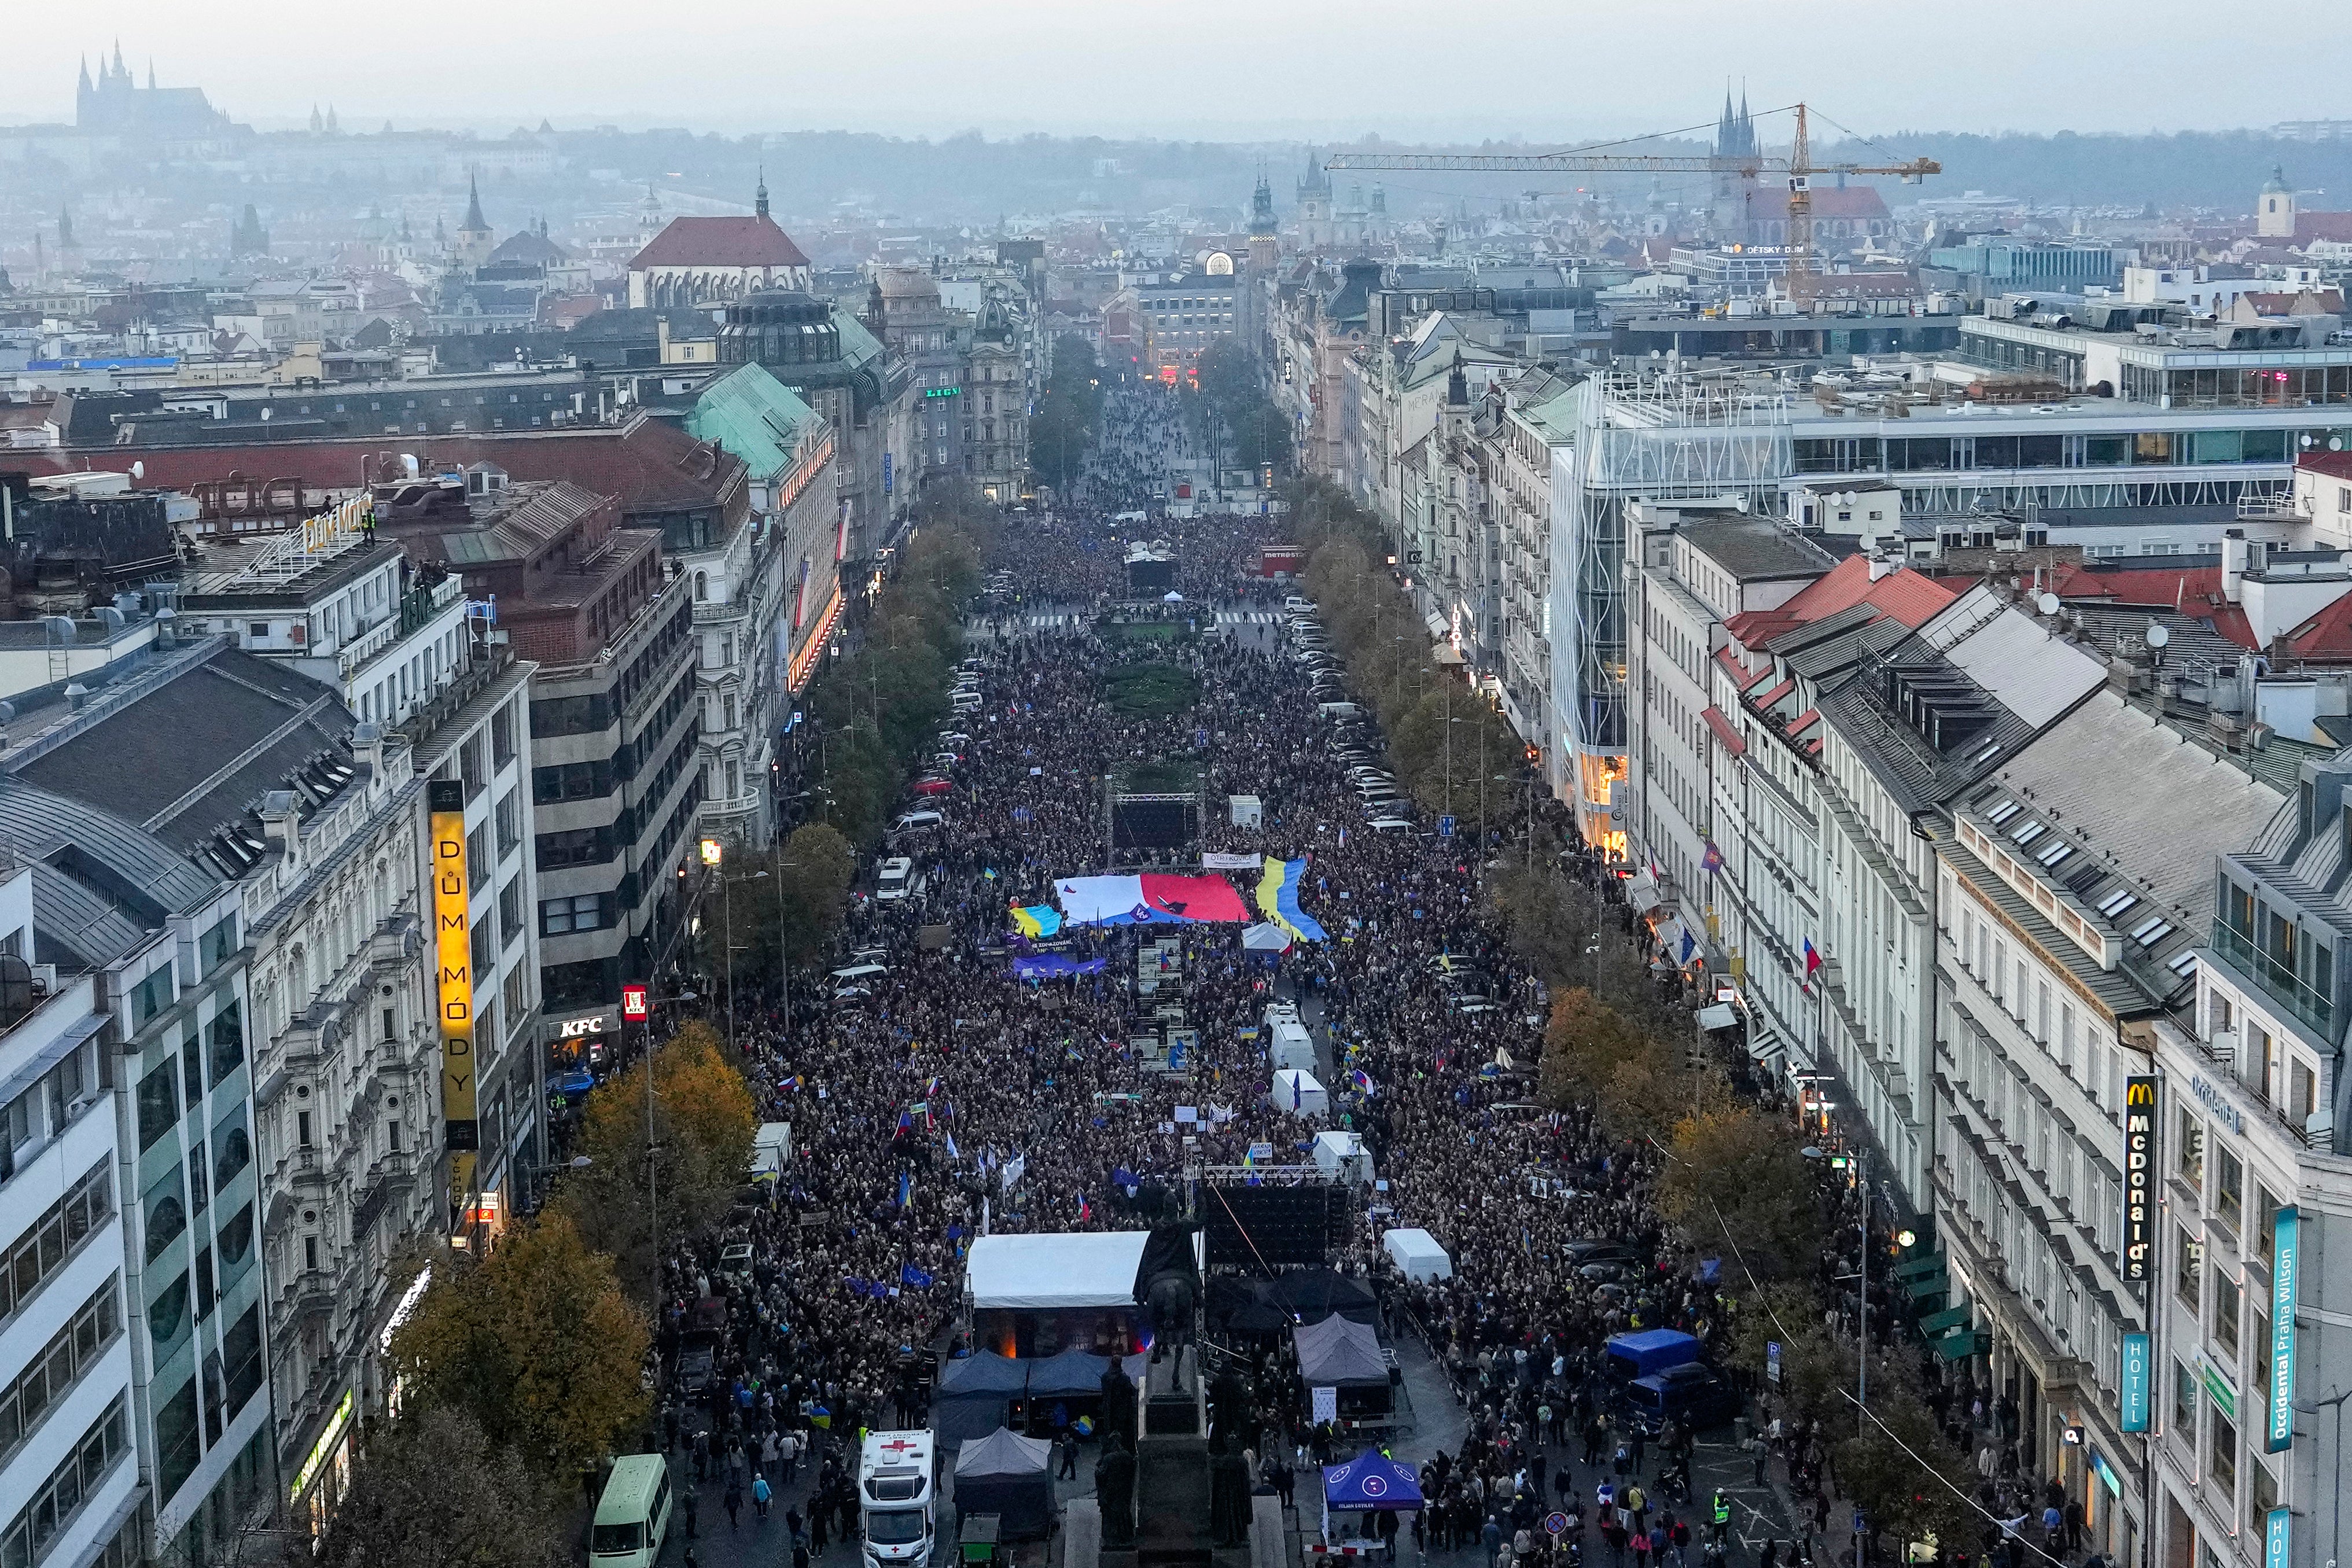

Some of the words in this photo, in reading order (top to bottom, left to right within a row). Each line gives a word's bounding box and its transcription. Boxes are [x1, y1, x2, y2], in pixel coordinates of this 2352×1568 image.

[1451, 603, 1462, 651] LUXOR
[560, 1017, 603, 1037] KFC
[2192, 1075, 2240, 1135] Occidental
[452, 1157, 462, 1202] VCHOD
[2128, 1115, 2149, 1278] McDonald's
[2279, 1247, 2292, 1304] Wilson
[1771, 1344, 1778, 1355] P
[2277, 1305, 2290, 1350] Praha
[2130, 1343, 2141, 1423] HOTEL
[2274, 1353, 2289, 1440] Occidental
